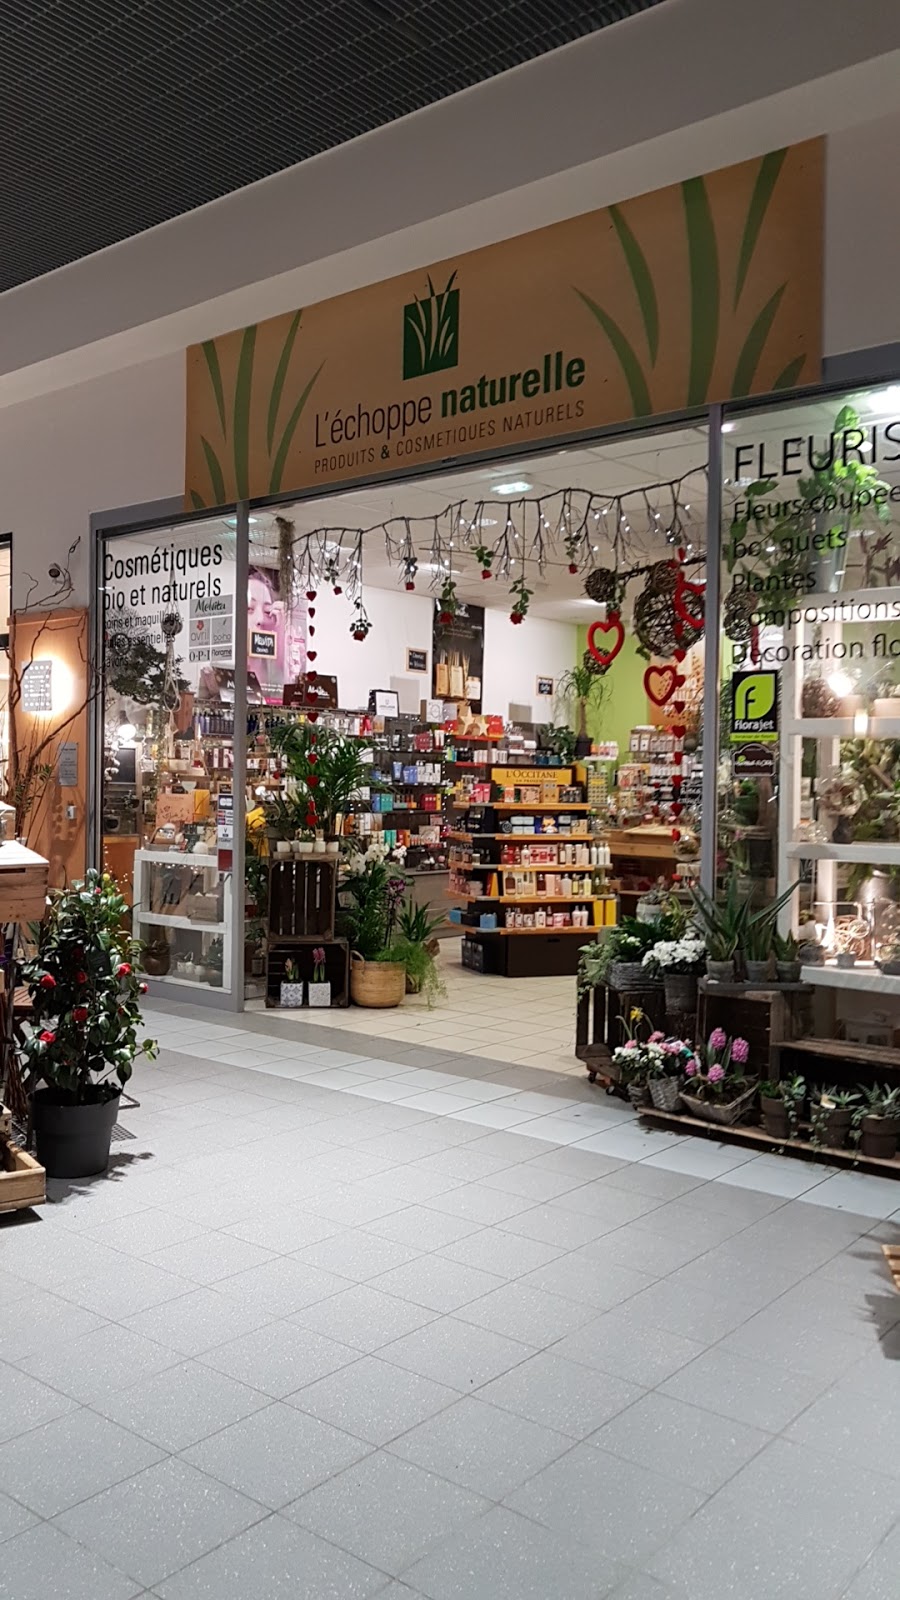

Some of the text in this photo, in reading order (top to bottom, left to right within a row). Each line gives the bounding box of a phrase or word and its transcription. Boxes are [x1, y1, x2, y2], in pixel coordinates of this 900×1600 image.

[315, 350, 586, 448] L'échoppe naturelle
[314, 400, 585, 474] PRODUITS & COSMETIQUES NATURELS
[734, 422, 900, 482] FLEURIS
[734, 498, 800, 523] Fleurs
[733, 529, 847, 560] boquets
[104, 543, 222, 581] Cosmétiques
[130, 585, 145, 607] et
[152, 572, 221, 604] naturels
[732, 571, 817, 593] Plantes
[104, 615, 123, 630] oins
[734, 719, 774, 731] florajet
